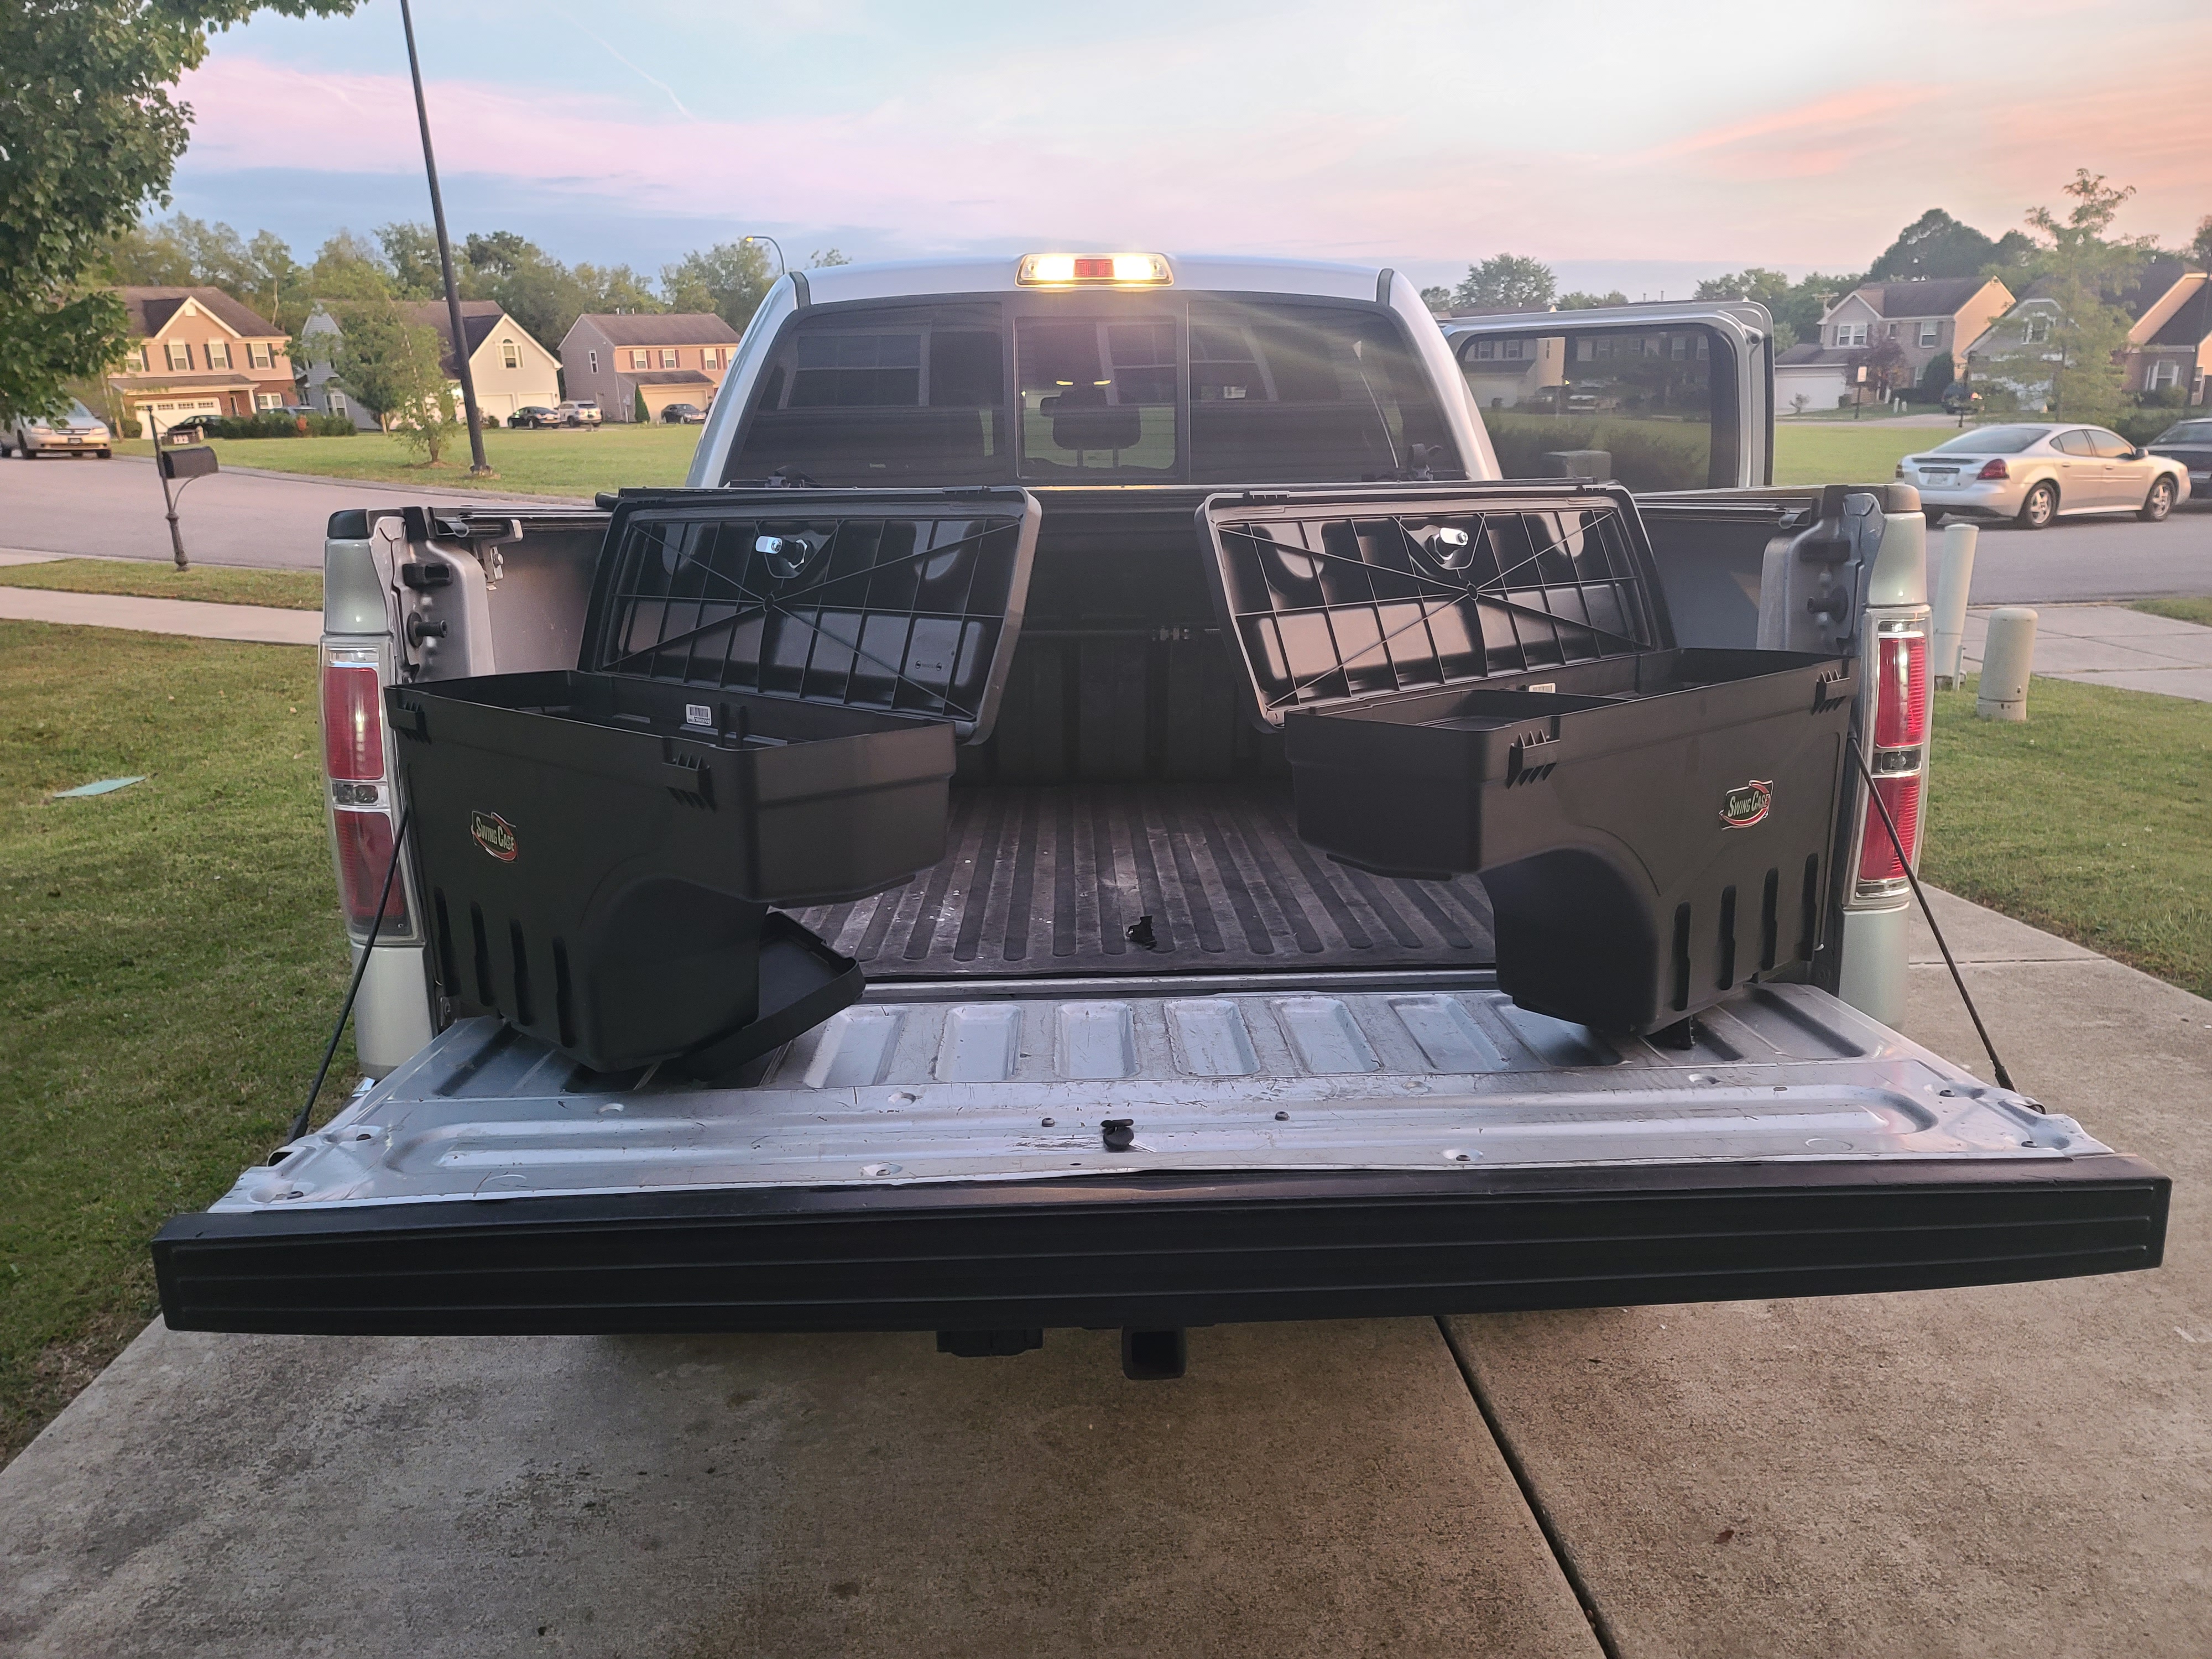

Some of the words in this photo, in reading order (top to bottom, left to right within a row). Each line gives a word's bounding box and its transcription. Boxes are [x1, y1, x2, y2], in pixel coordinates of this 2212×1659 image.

[1728, 796, 1751, 817] SWING
[1751, 790, 1770, 811] CASE
[476, 816, 498, 845] SWING
[497, 825, 515, 852] CASE
